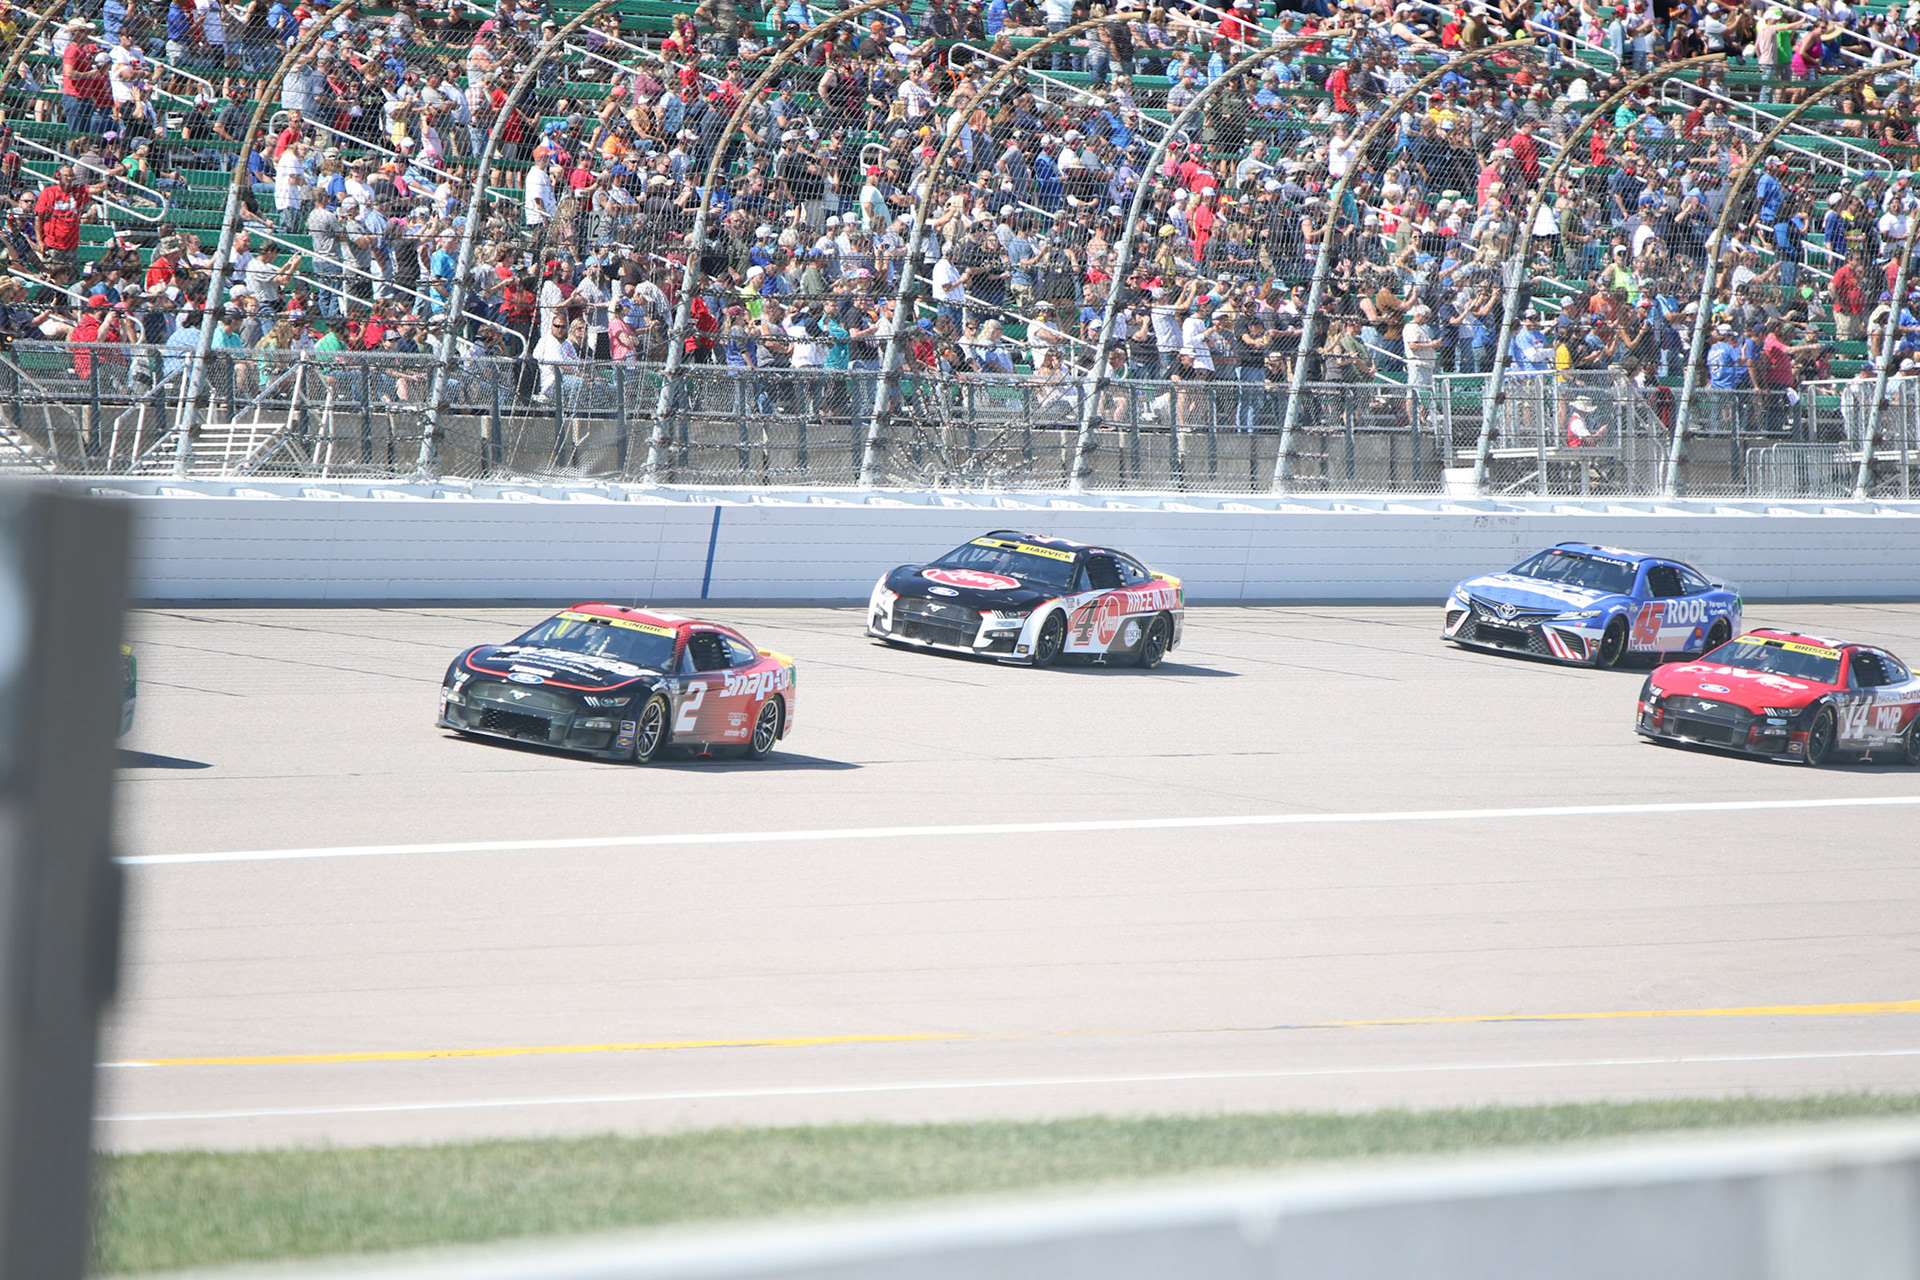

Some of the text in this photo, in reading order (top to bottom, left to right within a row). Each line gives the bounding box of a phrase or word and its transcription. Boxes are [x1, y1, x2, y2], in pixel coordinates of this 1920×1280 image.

[1024, 545, 1072, 560] HARVICK
[1591, 555, 1629, 567] WALLACE
[622, 621, 663, 633] CINDRIC
[1072, 597, 1100, 647] 4
[1632, 600, 1667, 645] 45
[674, 680, 708, 731] 2
[1840, 695, 1873, 739] 14
[1875, 706, 1902, 730] MVP
